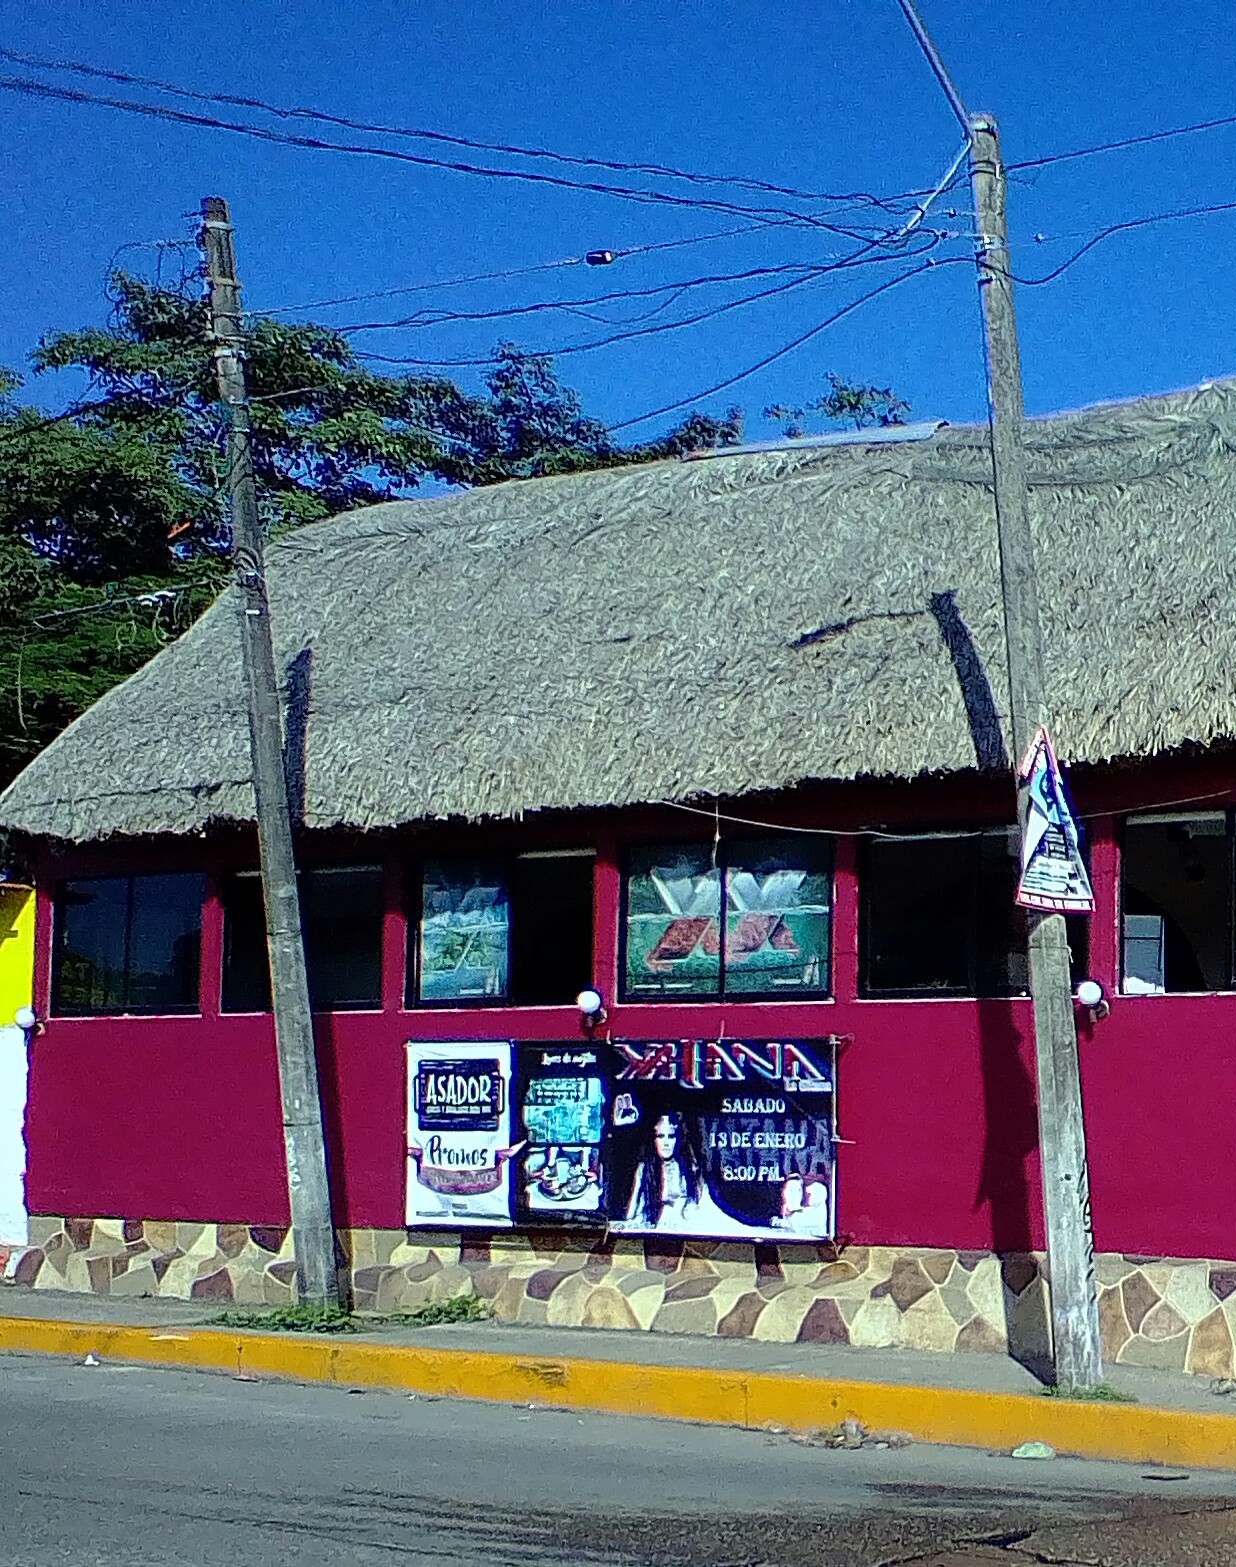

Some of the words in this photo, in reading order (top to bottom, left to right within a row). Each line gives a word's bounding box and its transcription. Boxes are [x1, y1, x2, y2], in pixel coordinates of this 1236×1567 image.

[427, 1073, 492, 1105] ASADOR
[721, 1098, 785, 1113] SABADO
[709, 1132, 728, 1148] 13
[730, 1132, 752, 1148] DE
[754, 1132, 806, 1149] ENERO
[723, 1165, 756, 1181] 8:00
